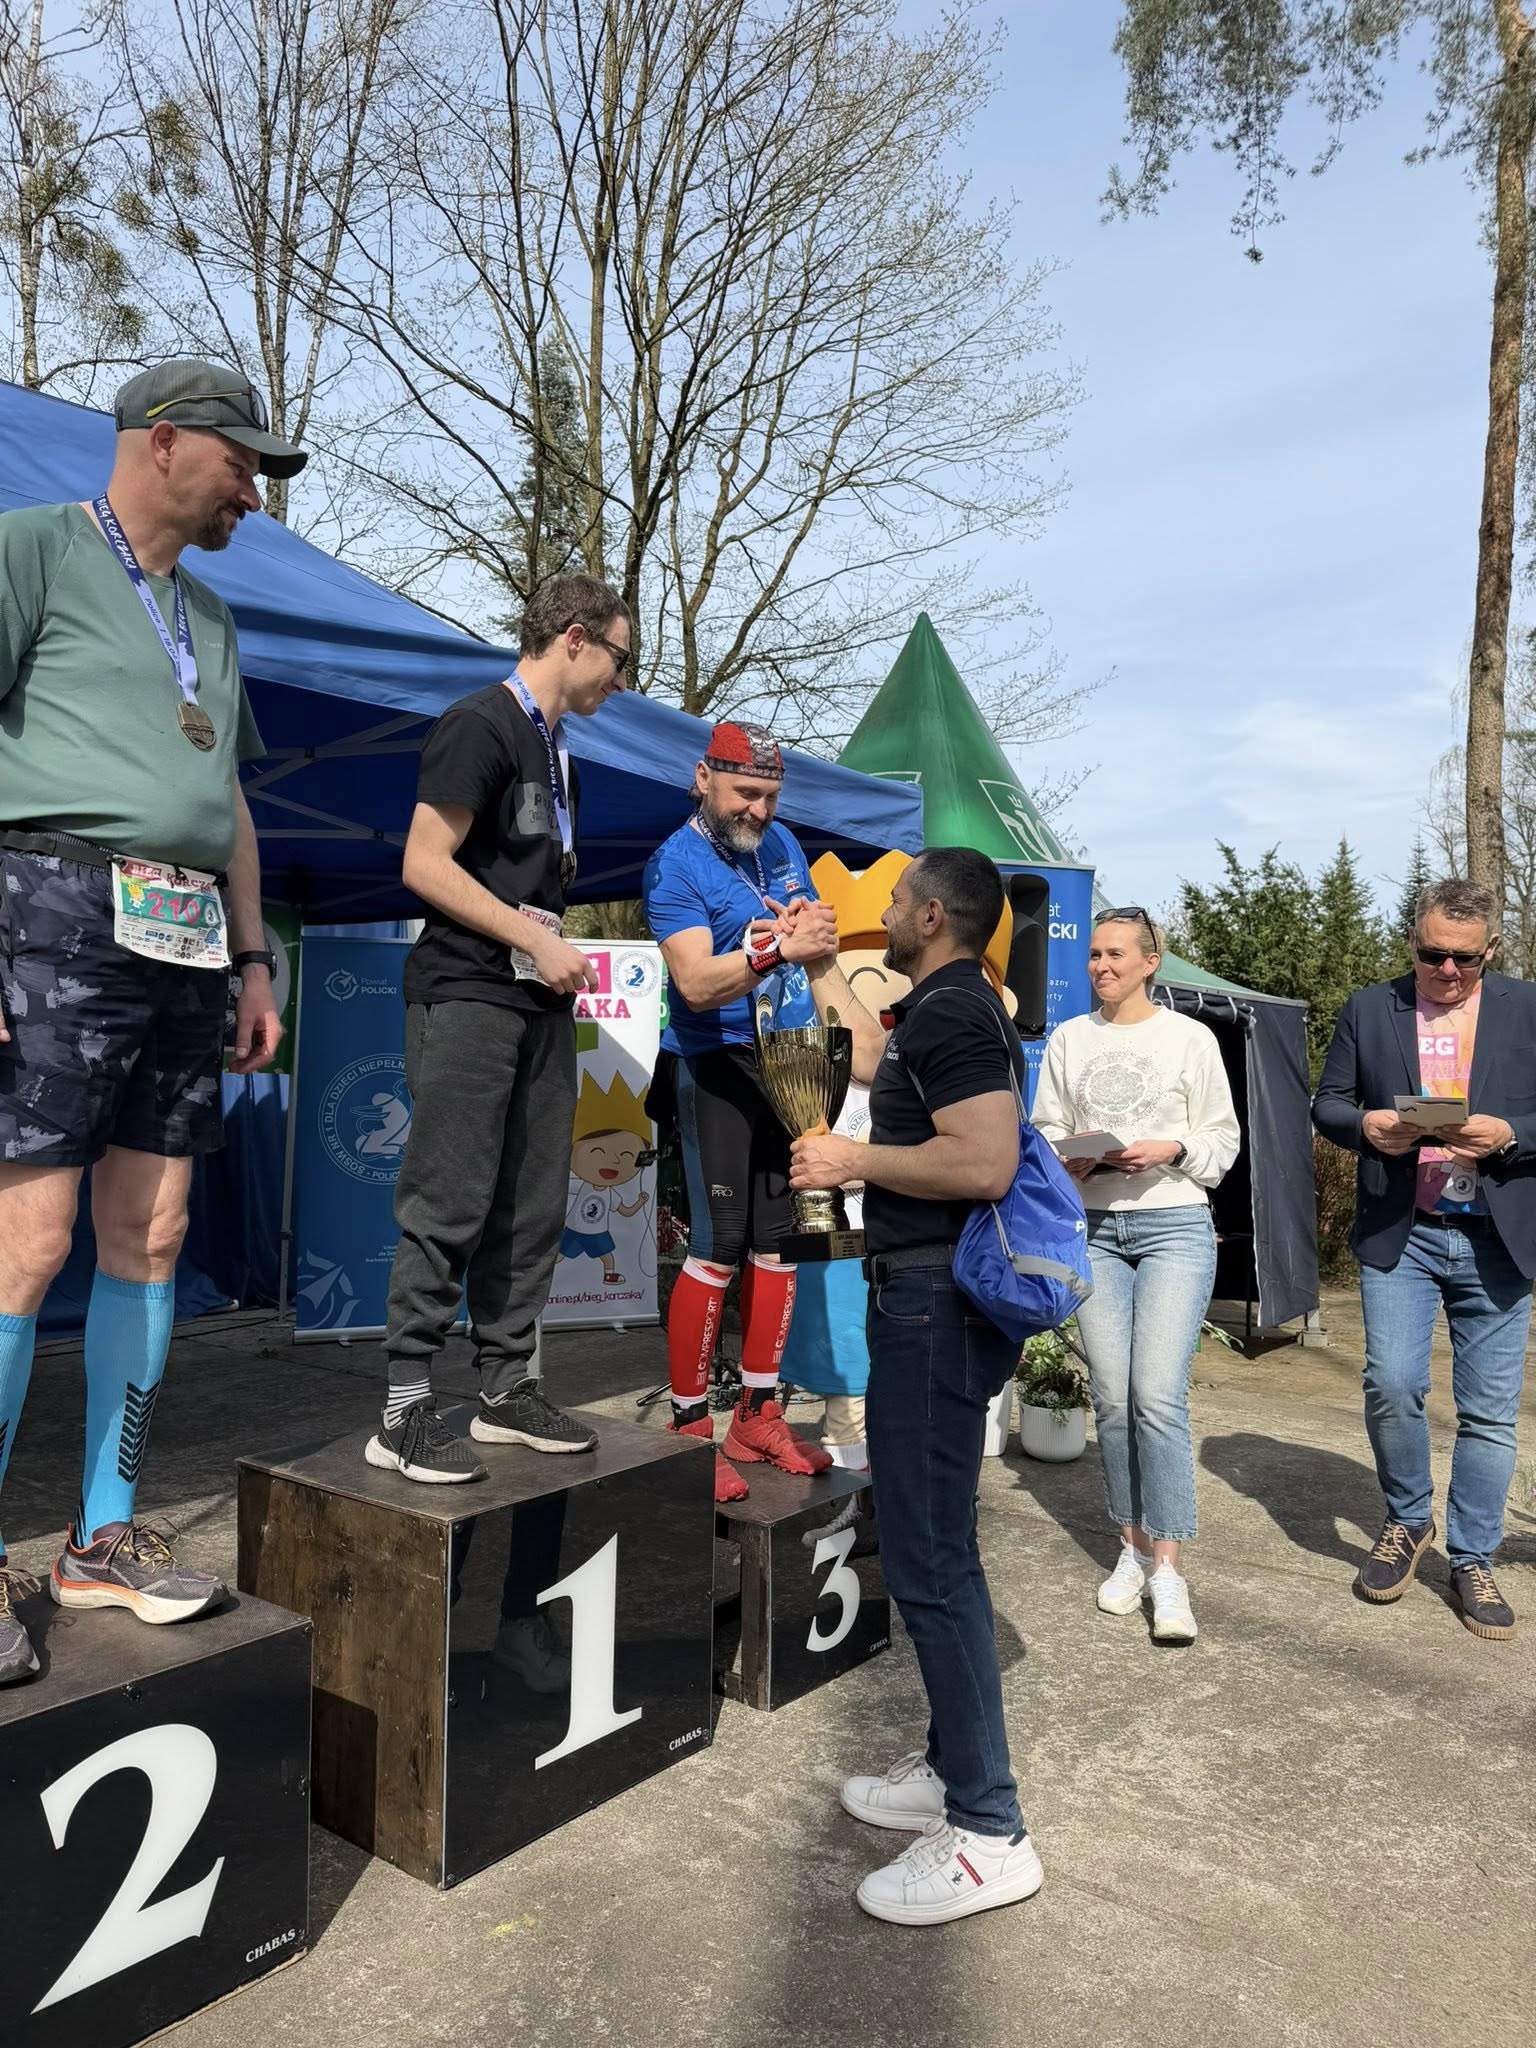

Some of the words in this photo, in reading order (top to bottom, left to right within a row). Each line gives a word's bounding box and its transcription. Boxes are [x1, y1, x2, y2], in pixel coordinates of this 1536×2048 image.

[147, 892, 200, 925] 210
[1048, 923, 1078, 940] CKI
[361, 977, 388, 985] Powiat
[361, 986, 397, 994] POLICKI
[575, 998, 631, 1019] AKA
[330, 1070, 359, 1100] DZIECI
[325, 1100, 337, 1124] DLA
[327, 1134, 341, 1151] NR
[336, 1148, 366, 1175] SOSW
[711, 1189, 733, 1197] PRO
[1075, 1220, 1085, 1233] P
[805, 1527, 861, 1653] 3
[535, 1532, 642, 1771] 1
[668, 1726, 702, 1752] CHABAS
[30, 1723, 225, 2016] 2
[244, 1928, 296, 1963] CHABAS
